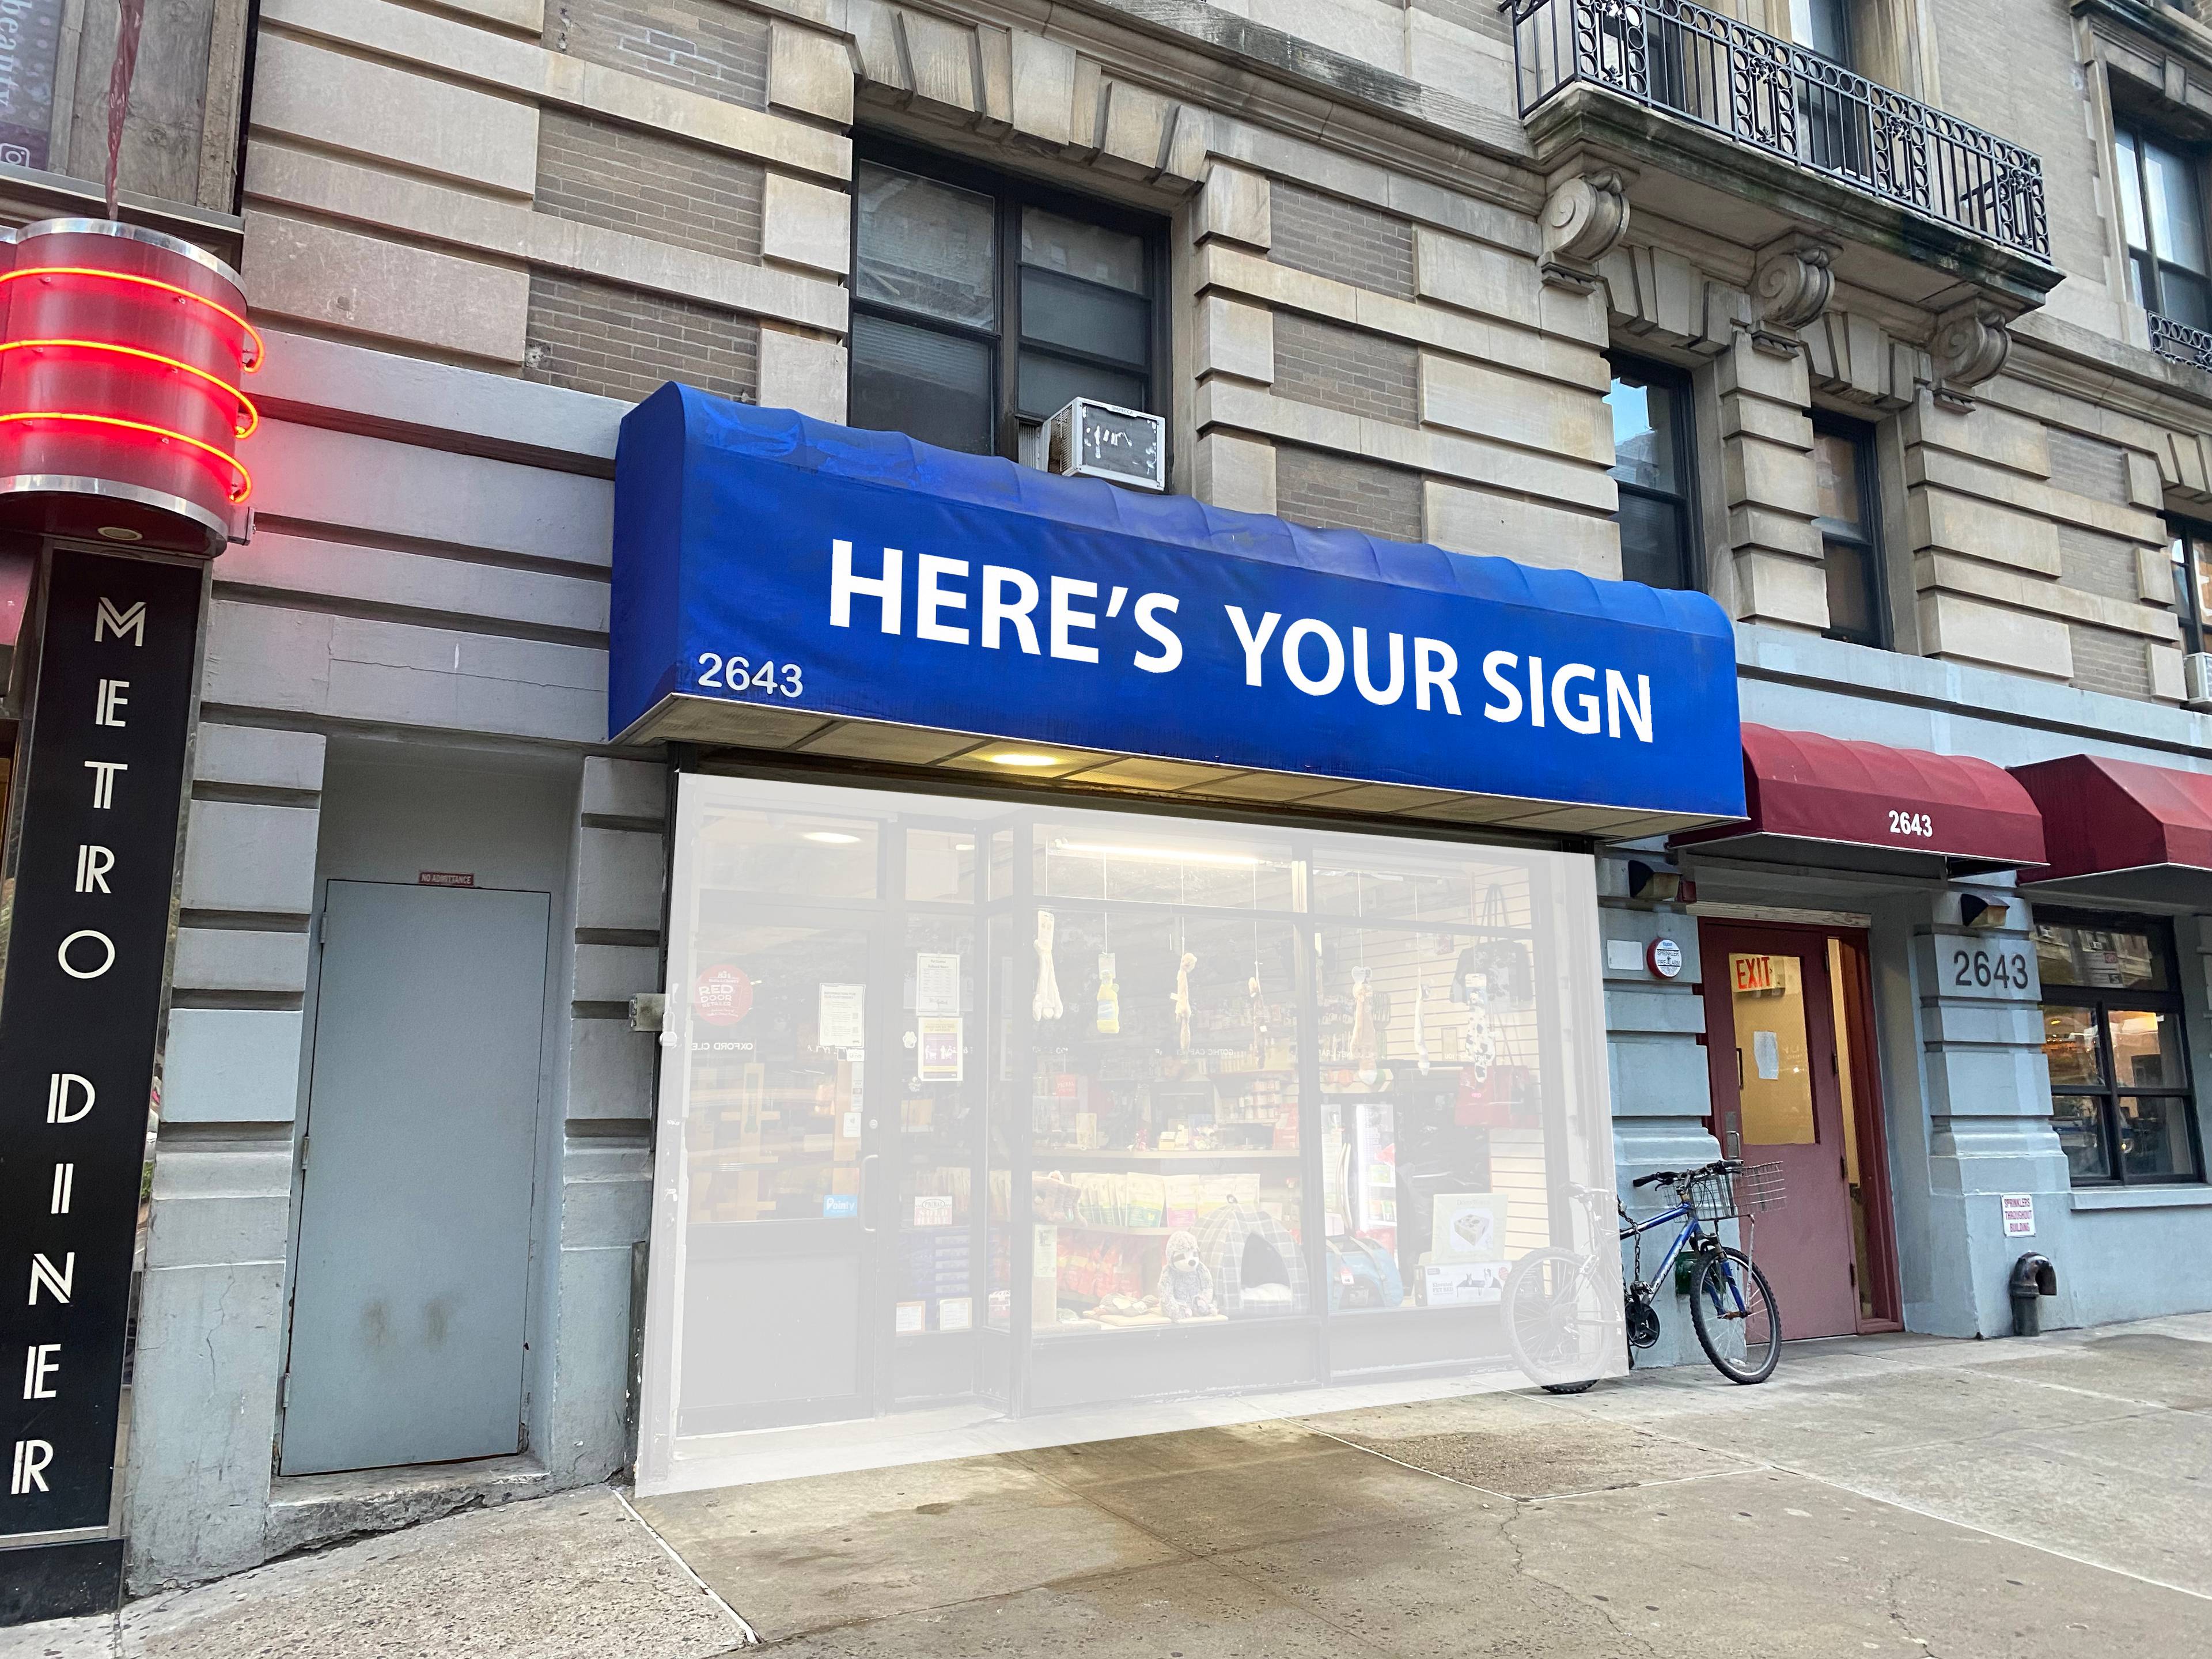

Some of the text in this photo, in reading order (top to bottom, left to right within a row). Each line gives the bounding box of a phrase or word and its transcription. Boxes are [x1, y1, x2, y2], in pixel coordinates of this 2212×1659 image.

[830, 538, 1653, 743] HERE'S YOUR SIGN
[698, 652, 804, 698] 2643
[1888, 810, 1933, 838] 2643
[421, 873, 471, 884] NO ADMITTANCE
[1736, 956, 1770, 989] EXIT
[1953, 950, 2028, 989] 2643
[699, 984, 733, 995] RED
[700, 995, 732, 1003] DOOR
[10, 597, 146, 1495] METRO DINER
[826, 1198, 855, 1210] Pointy
[2004, 1198, 2031, 1207] SPRINKLERS
[2005, 1210, 2032, 1219] THROUGHOUT
[2010, 1222, 2030, 1232] BUILDING
